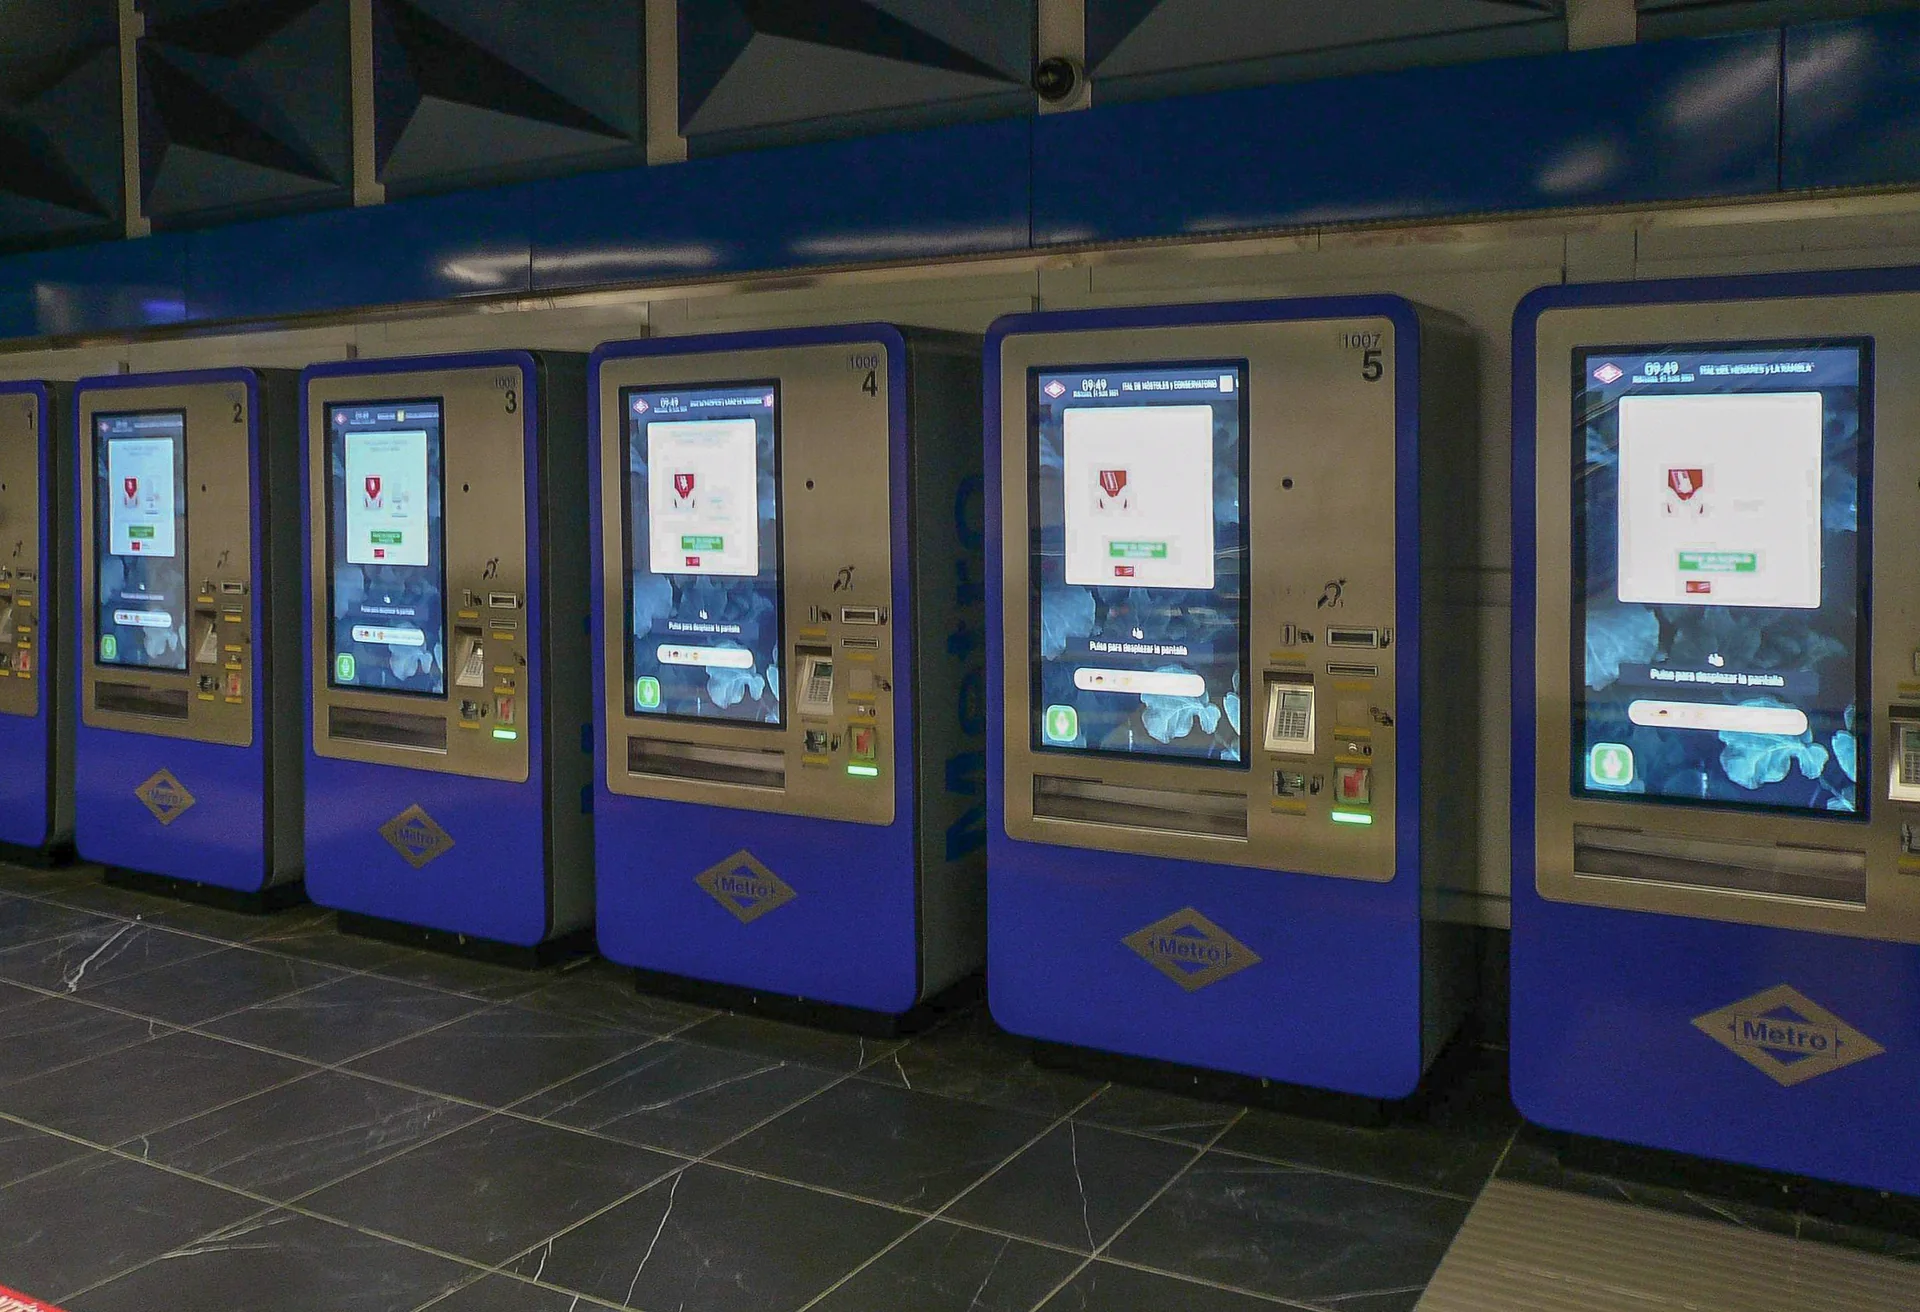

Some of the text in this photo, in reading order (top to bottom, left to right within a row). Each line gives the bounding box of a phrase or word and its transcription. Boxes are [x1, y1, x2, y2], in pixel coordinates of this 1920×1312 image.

[1343, 332, 1382, 349] 1007
[1362, 349, 1384, 381] 5
[1644, 361, 1679, 376] 09:49
[861, 369, 879, 398] 4
[1082, 378, 1107, 391] 09:49
[505, 389, 517, 414] 3
[28, 410, 33, 429] 1
[232, 402, 243, 423] 2
[1747, 675, 1784, 687] pantalla
[721, 877, 768, 898] Metro
[1159, 938, 1222, 962] Metro
[1743, 1020, 1828, 1051] Metro
